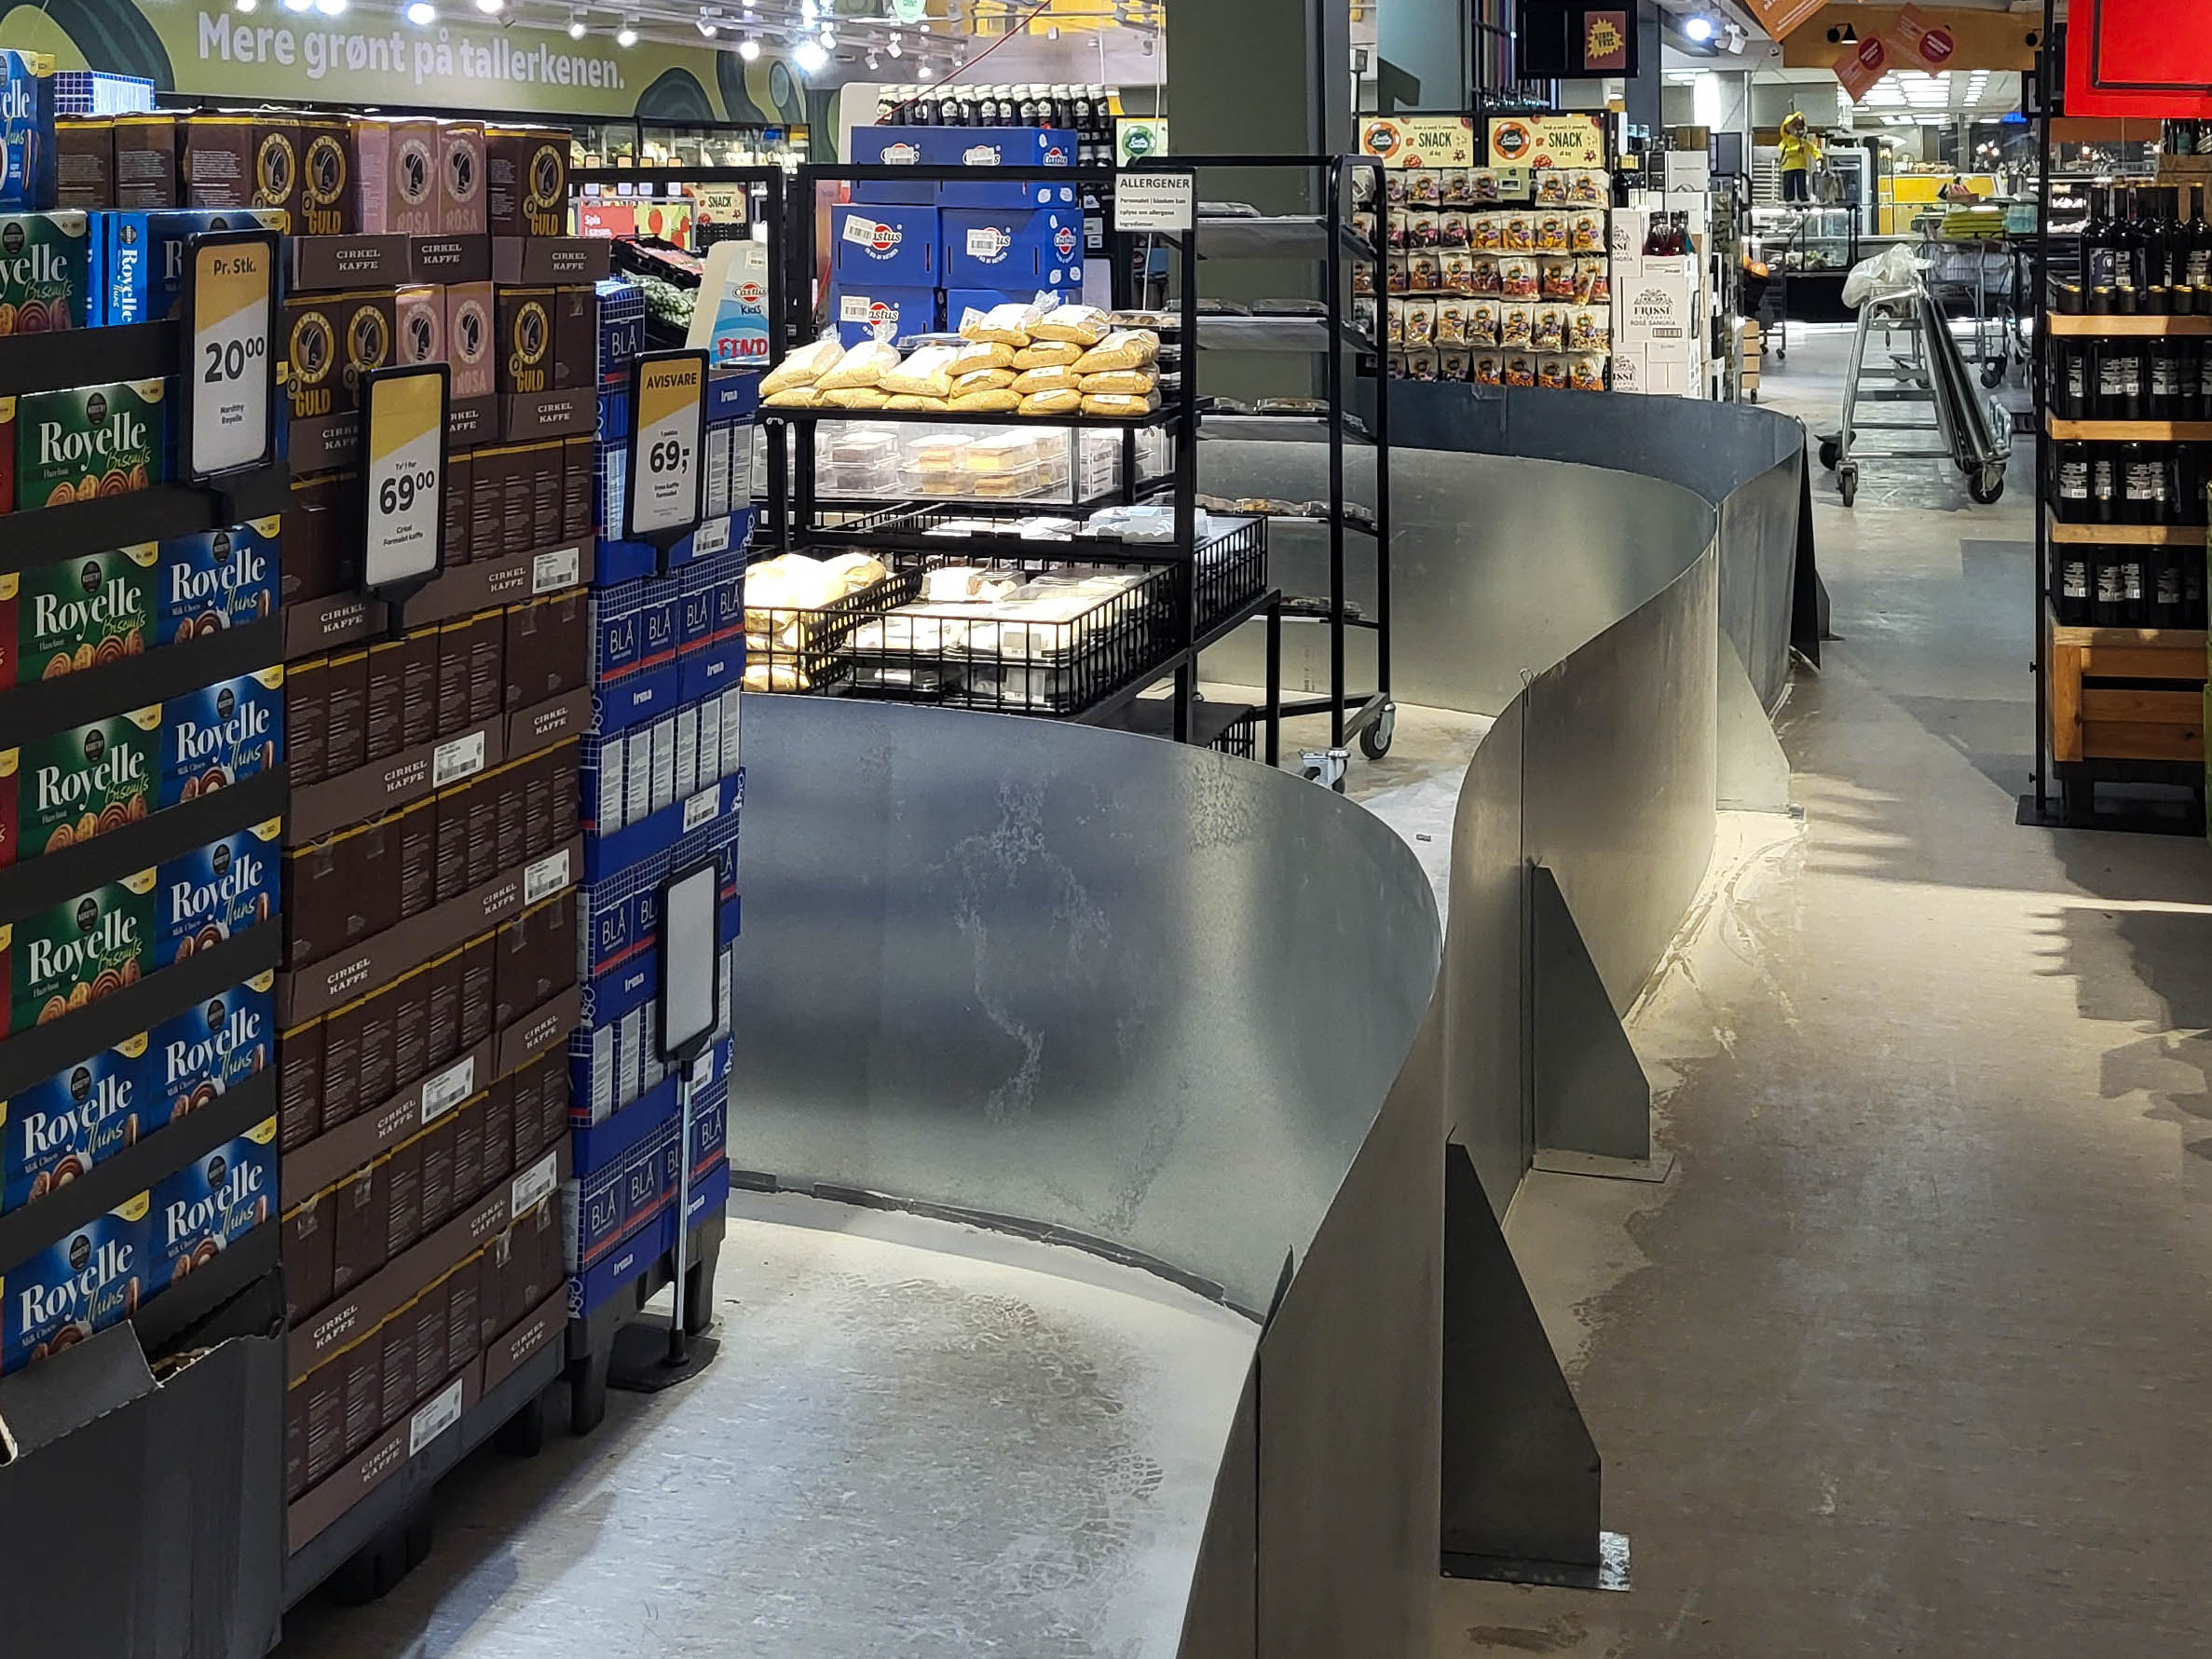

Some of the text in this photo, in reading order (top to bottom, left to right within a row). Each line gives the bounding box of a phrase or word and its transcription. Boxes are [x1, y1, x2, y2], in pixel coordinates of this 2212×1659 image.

[198, 12, 625, 89] Mere grønt på tallerkenen.
[1418, 132, 1452, 147] SNACK
[1549, 132, 1582, 147] SNACK
[1120, 179, 1190, 188] ALLERGENER
[309, 211, 341, 234] GULD
[531, 214, 558, 236] GULD
[336, 249, 380, 259] CIRKEL
[421, 244, 462, 252] CIRKEL
[423, 255, 460, 264] KAFFE
[552, 252, 587, 260] CIRKEL
[213, 257, 257, 276] Pr. Stk.
[339, 261, 378, 271] KAFFE
[553, 262, 584, 270] KAFFE
[121, 248, 138, 323] Royelle
[868, 309, 898, 320] astus
[611, 324, 637, 357] BLÅ
[517, 369, 544, 393] GULD
[646, 373, 697, 389] AVISVARE
[295, 388, 331, 417] GULD
[538, 402, 573, 413] CIRKEL
[720, 389, 738, 403] Irma
[449, 421, 477, 432] AFFE
[451, 410, 479, 420] RKEL
[539, 413, 570, 423] KAFFE
[38, 411, 147, 470] Royelle
[322, 425, 359, 439] CIRKE
[325, 437, 358, 450] KAFF
[170, 548, 266, 606] Royelle
[488, 566, 526, 582] CIRKEL
[490, 578, 524, 593] KAFFE
[34, 578, 142, 642] Royelle
[687, 595, 708, 627] BLÅ
[720, 583, 740, 615] BLÅ
[321, 604, 365, 622] CIRKEL
[322, 615, 363, 633] KAFFE
[649, 607, 671, 640] BLÅ
[609, 619, 634, 654] BLÅ
[706, 661, 724, 676] Irma
[633, 689, 652, 705] Irma
[534, 707, 568, 725] CIRKEL
[536, 717, 567, 735] KAFFE
[175, 700, 270, 763] Royelle
[36, 742, 144, 810] Royelle
[384, 759, 428, 782] CIRKEL
[386, 772, 425, 792] KAFFE
[171, 853, 264, 925] Royelle
[483, 883, 517, 904] CIRKEL
[484, 894, 515, 915] KAFFE
[640, 899, 657, 924] BL
[602, 906, 626, 945] BLÅ
[28, 908, 138, 986] Royelle
[327, 958, 371, 984] CIRKEL
[329, 970, 368, 994] KAFFE
[525, 1014, 558, 1040] CIRKEL
[526, 1026, 556, 1049] KAFFE
[165, 1006, 261, 1085] Royelle
[21, 1074, 132, 1163] Royelle
[377, 1099, 416, 1129] CIRKEL
[378, 1111, 414, 1138] KAFFE
[701, 1108, 722, 1147] BLÅ
[666, 1146, 679, 1174] BL
[631, 1160, 655, 1202] BLÅ
[165, 1160, 264, 1248] Royelle
[471, 1199, 506, 1230] CIRKEL
[591, 1190, 617, 1231] BLÅ
[471, 1210, 504, 1237] KAFFE
[19, 1239, 133, 1337] Royelle
[313, 1304, 358, 1339] CIRKEL
[315, 1315, 356, 1350] KAFFE
[511, 1319, 545, 1351] CIRKEL
[512, 1331, 543, 1360] KAFFE
[362, 1436, 403, 1474] CIRKEL
[362, 1447, 400, 1483] KAFFE
